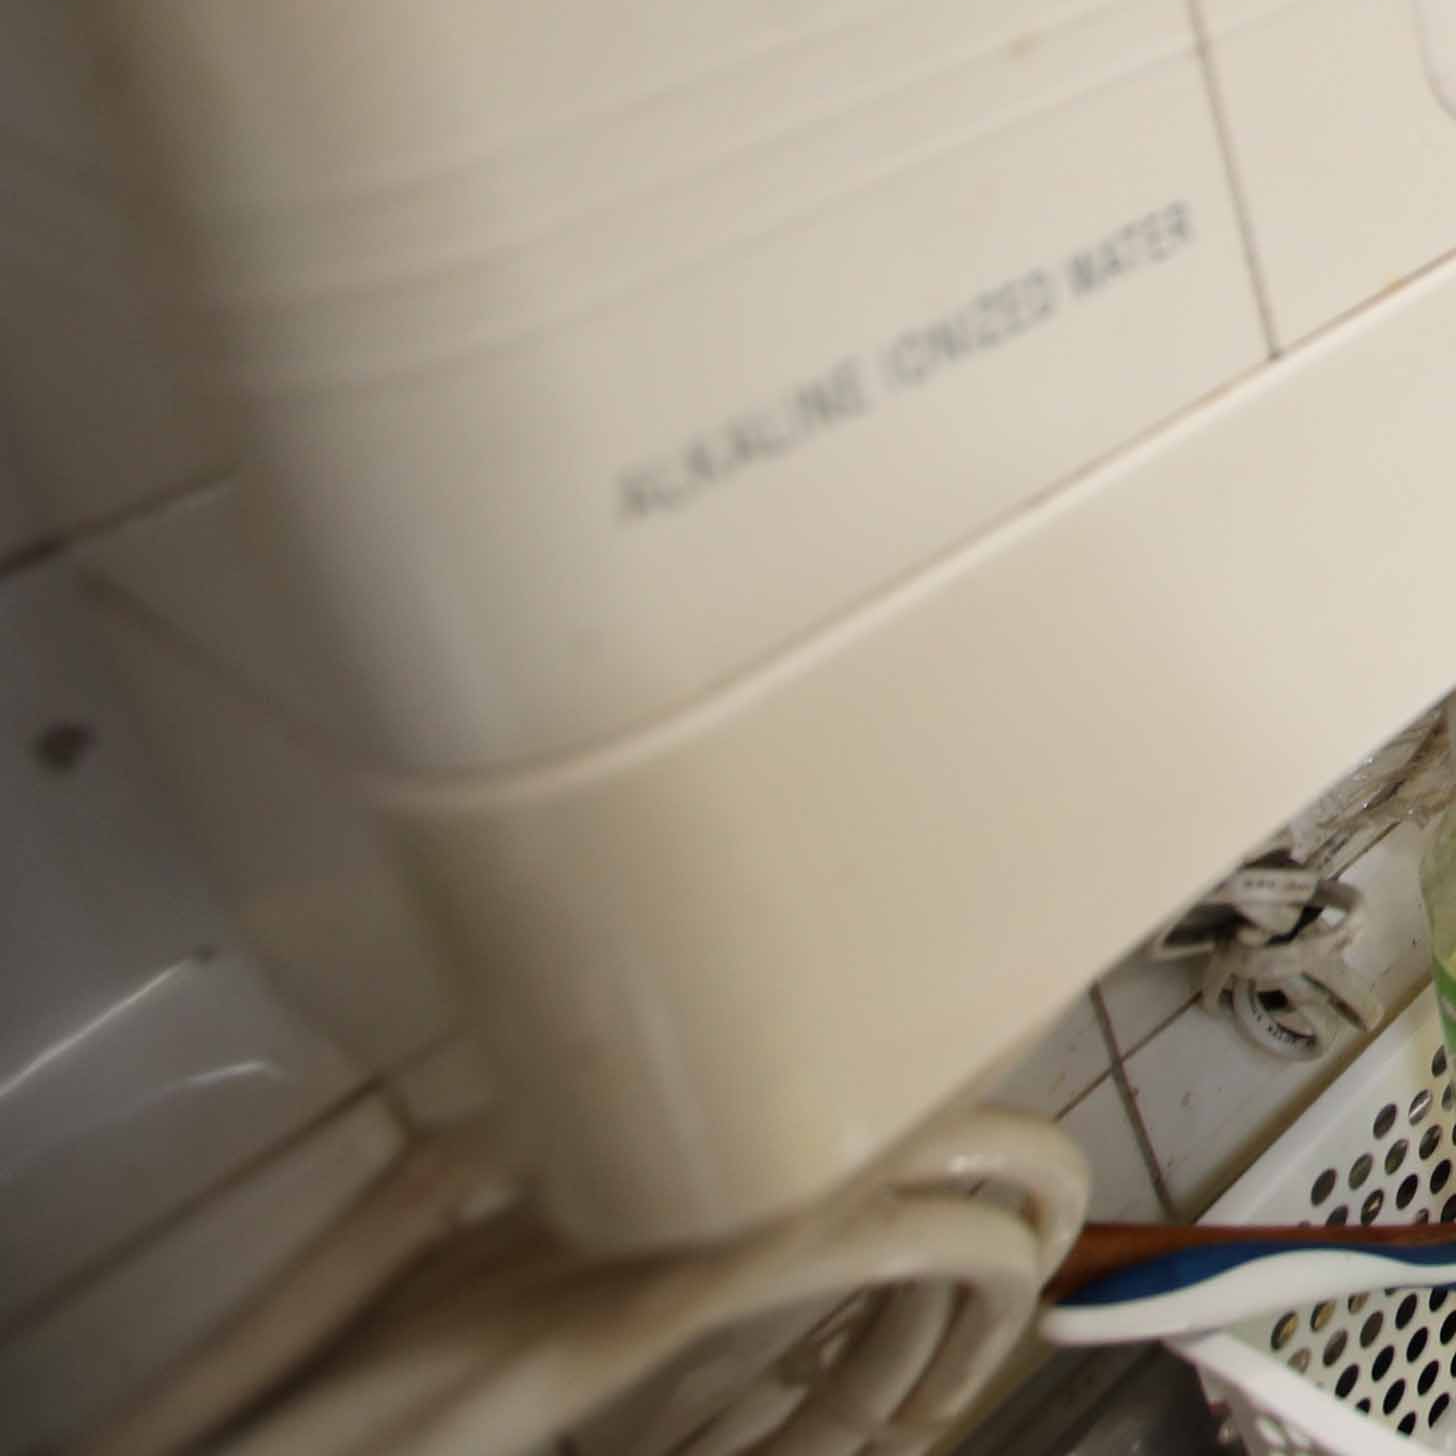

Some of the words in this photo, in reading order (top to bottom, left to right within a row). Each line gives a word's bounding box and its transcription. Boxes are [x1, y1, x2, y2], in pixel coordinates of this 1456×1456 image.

[619, 356, 868, 522] ALKALINE
[885, 268, 1055, 390] IONIZED
[1066, 200, 1191, 296] WATER
